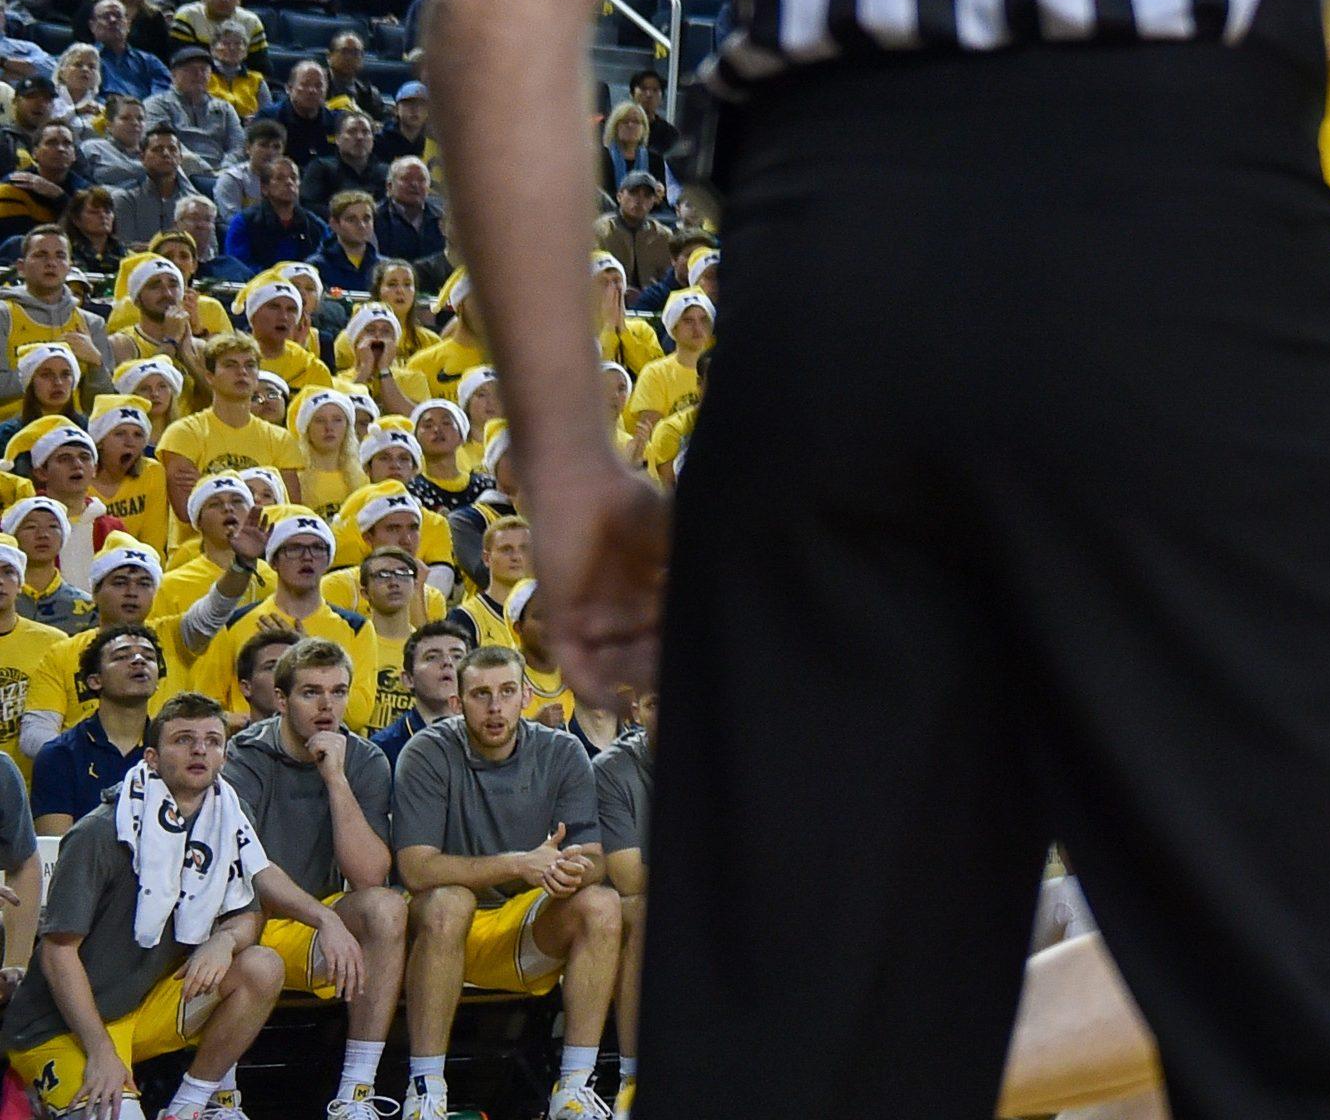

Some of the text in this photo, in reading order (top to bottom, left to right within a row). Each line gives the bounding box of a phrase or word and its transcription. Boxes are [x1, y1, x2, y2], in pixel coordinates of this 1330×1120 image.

[121, 409, 139, 420] M
[391, 432, 408, 444] M
[214, 479, 234, 489] M
[387, 496, 408, 507] M
[297, 518, 319, 530] M
[125, 549, 147, 562] M
